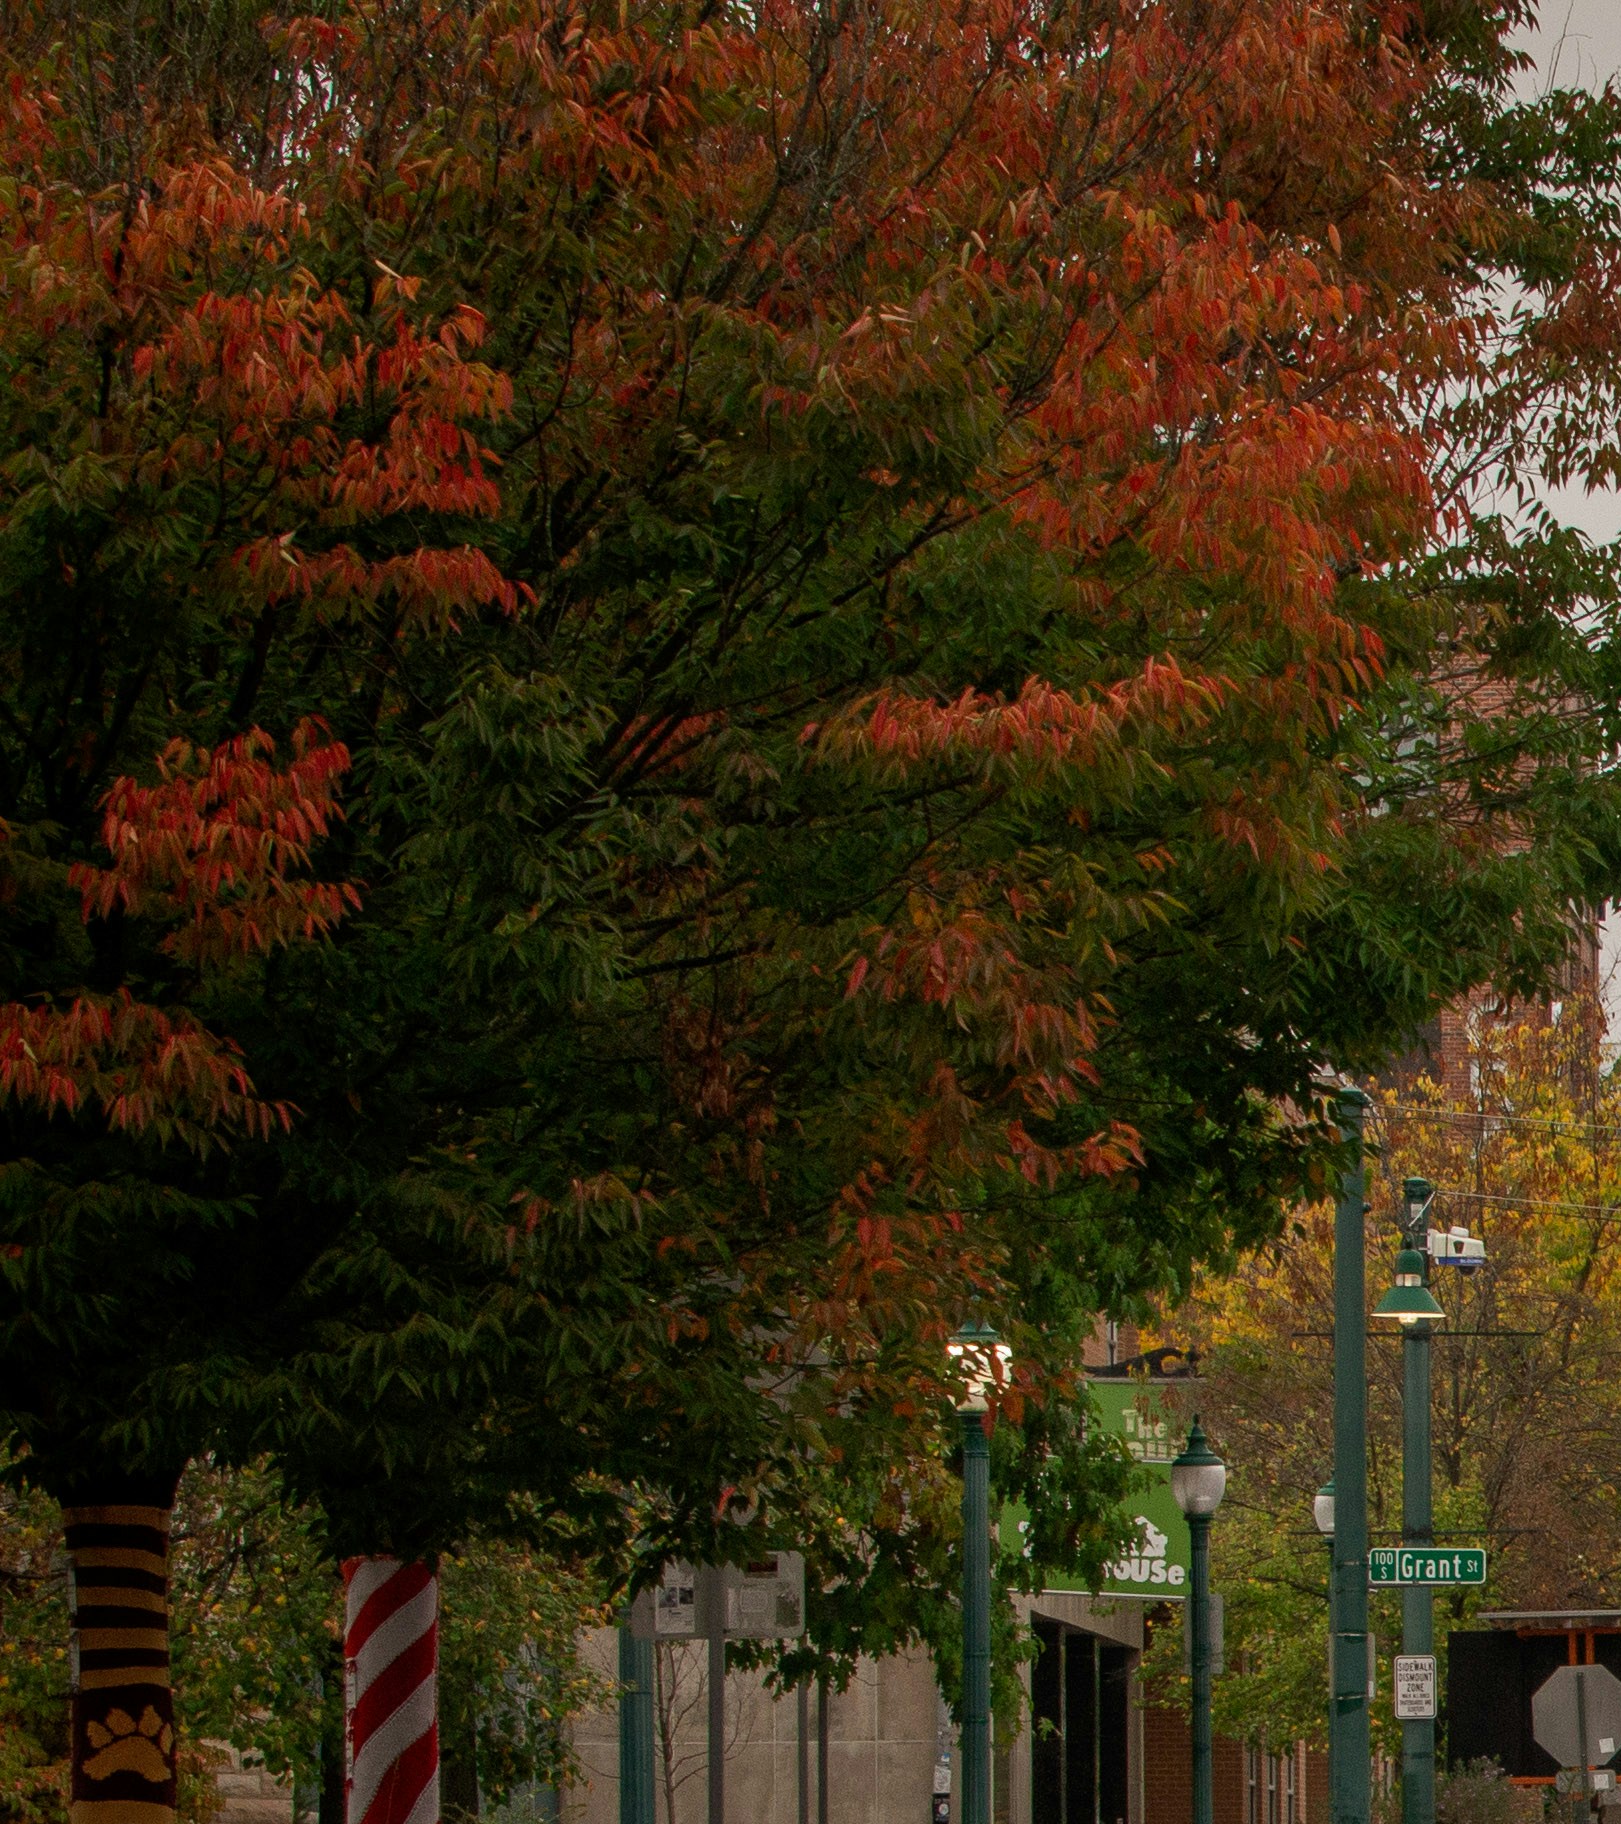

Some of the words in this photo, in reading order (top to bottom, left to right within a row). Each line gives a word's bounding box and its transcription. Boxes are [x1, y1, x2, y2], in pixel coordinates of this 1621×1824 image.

[1121, 1409, 1168, 1439] The
[1374, 1552, 1394, 1565] 100
[1401, 1553, 1462, 1579] Grant
[1466, 1559, 1479, 1573] St
[1380, 1566, 1388, 1580] S
[1398, 1662, 1434, 1671] SIDEWALK
[1398, 1672, 1433, 1682] DISMOUNT
[1407, 1683, 1424, 1692] ZONE
